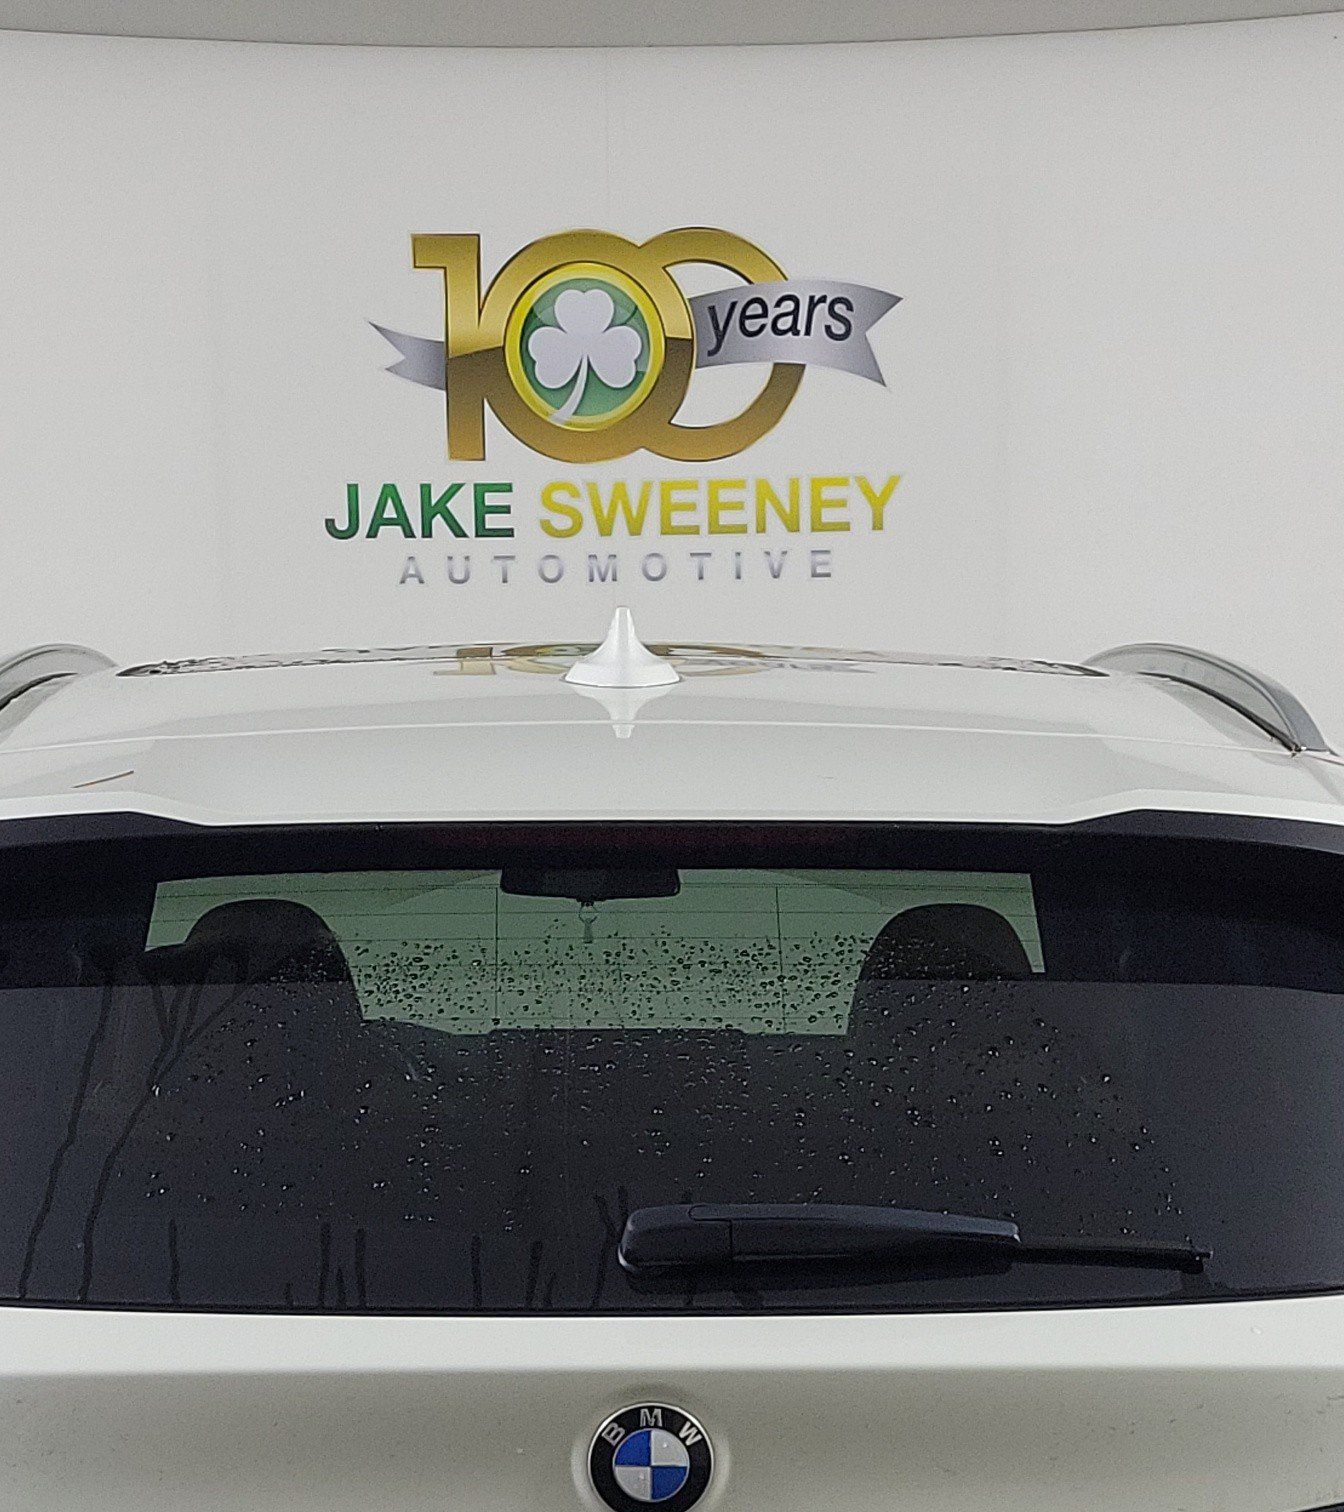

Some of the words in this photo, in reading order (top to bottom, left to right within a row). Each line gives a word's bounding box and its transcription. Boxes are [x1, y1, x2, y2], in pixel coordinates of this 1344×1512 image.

[411, 227, 805, 464] 100
[706, 291, 854, 358] years
[324, 482, 514, 539] JAKE
[539, 475, 901, 537] SWEENEY
[398, 549, 833, 585] AUTOMOTIVE
[601, 1408, 703, 1447] BMW
